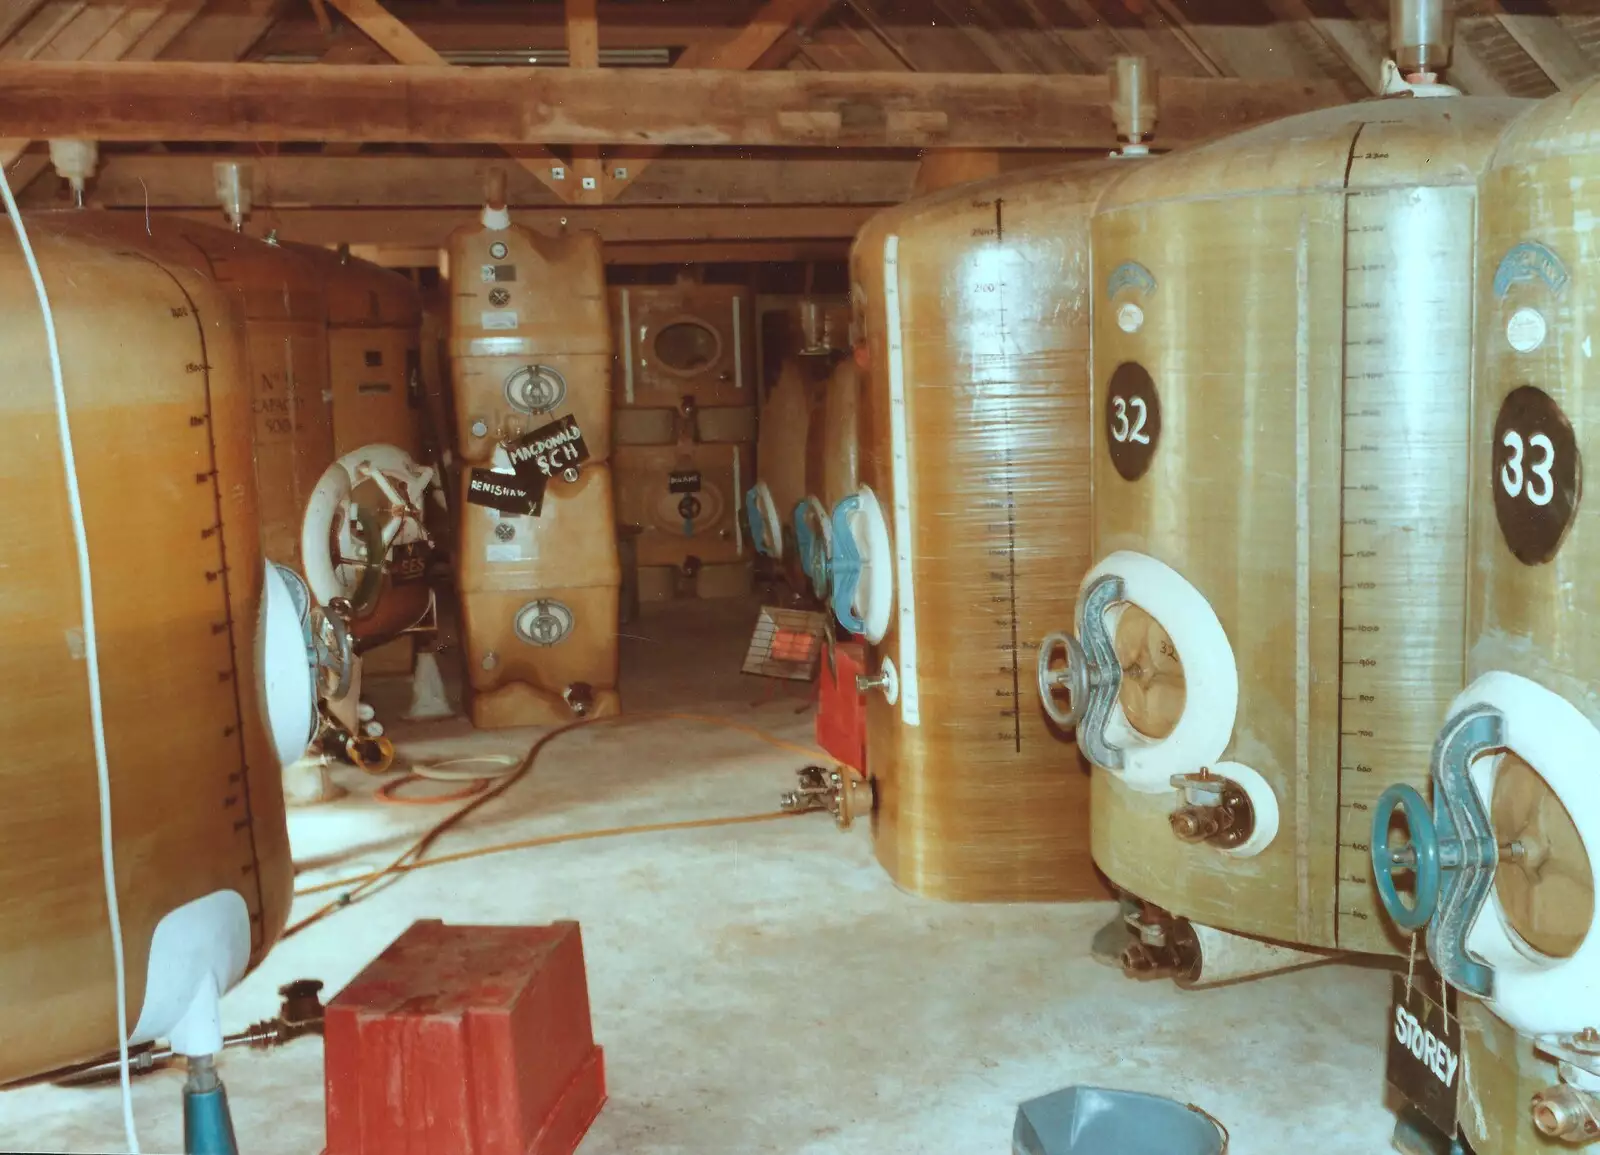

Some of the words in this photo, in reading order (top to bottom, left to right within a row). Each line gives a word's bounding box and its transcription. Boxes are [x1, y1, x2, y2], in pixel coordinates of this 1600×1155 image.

[1111, 395, 1150, 445] 32
[511, 426, 581, 466] MACDONALD
[536, 443, 579, 471] SCH
[1501, 429, 1555, 507] 33
[470, 479, 528, 498] RENISHAW
[1358, 624, 1380, 633] 1000
[1160, 640, 1178, 661] 32
[1358, 658, 1377, 668] 900
[1358, 730, 1374, 738] 700
[1356, 764, 1372, 773] 600
[1352, 842, 1369, 852] 400
[1394, 1004, 1458, 1089] STOREY
